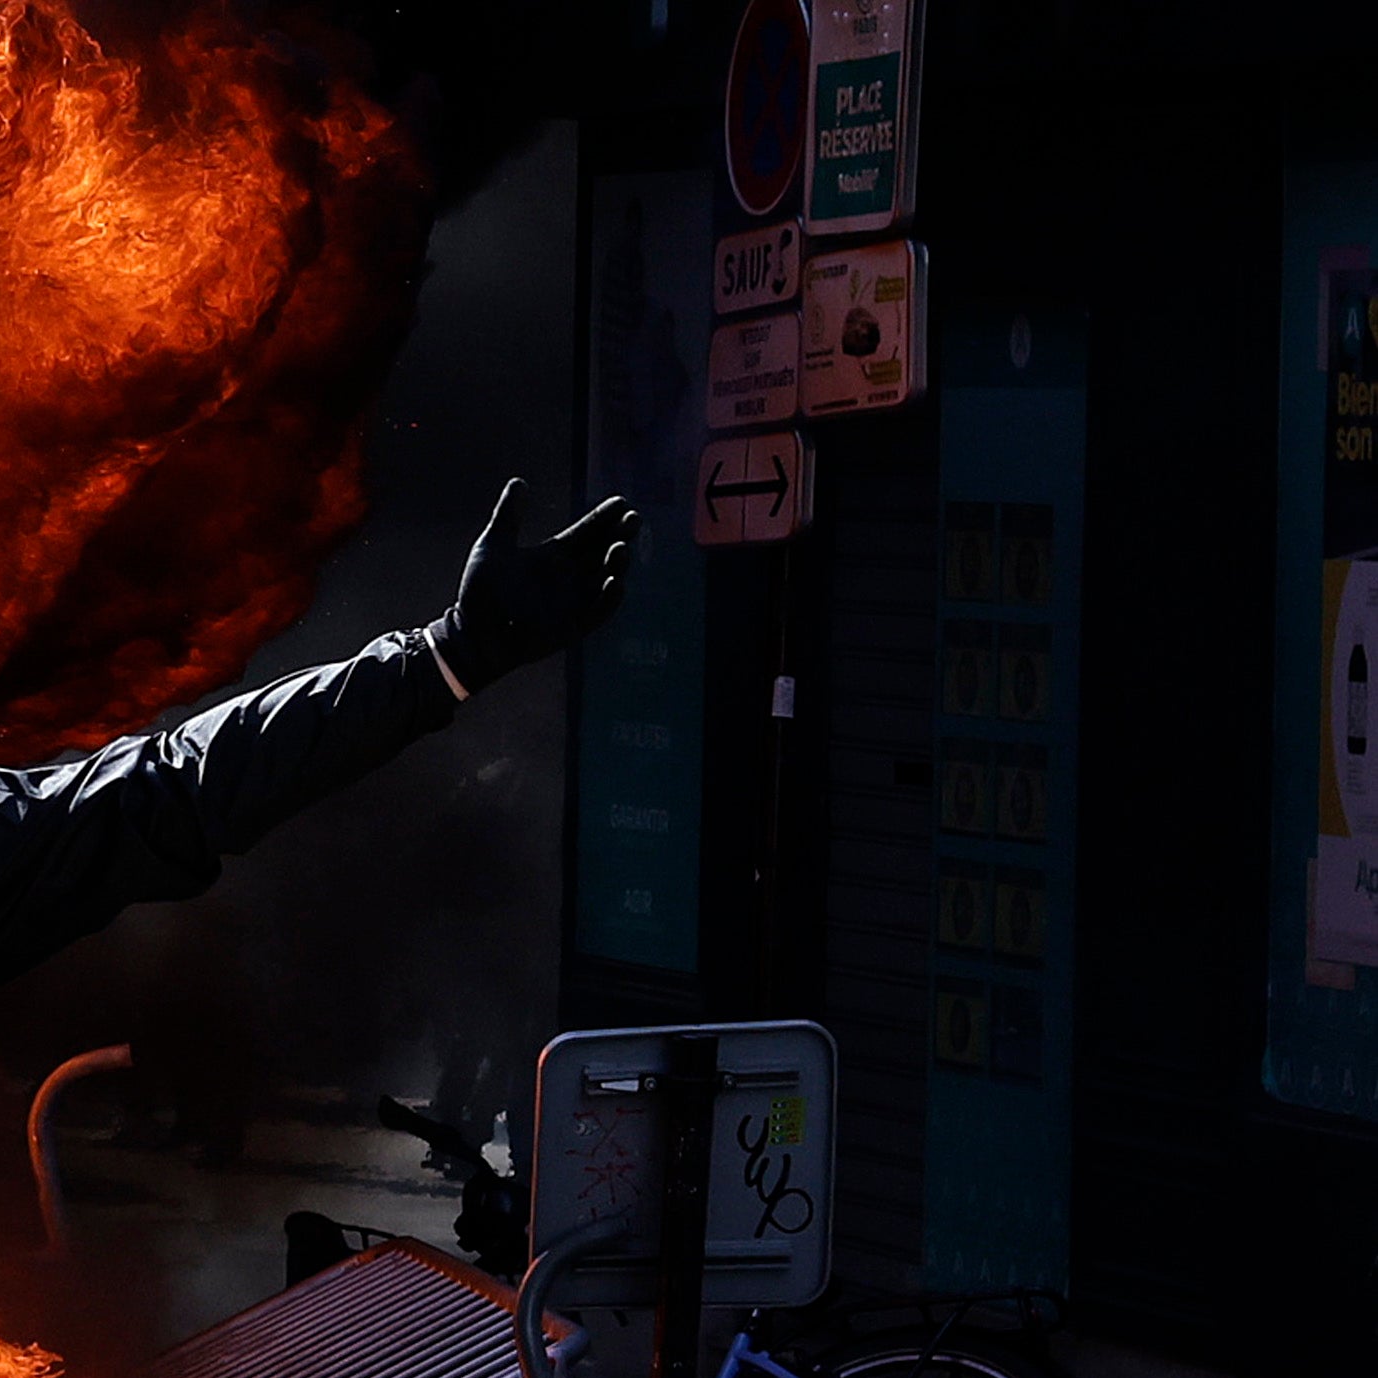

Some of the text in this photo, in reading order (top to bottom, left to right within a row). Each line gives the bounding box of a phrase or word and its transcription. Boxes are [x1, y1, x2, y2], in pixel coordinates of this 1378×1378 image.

[836, 80, 884, 116] PLACE
[819, 114, 894, 159] RÉSERVÉE
[722, 244, 772, 296] SAUF
[1335, 426, 1374, 461] son
